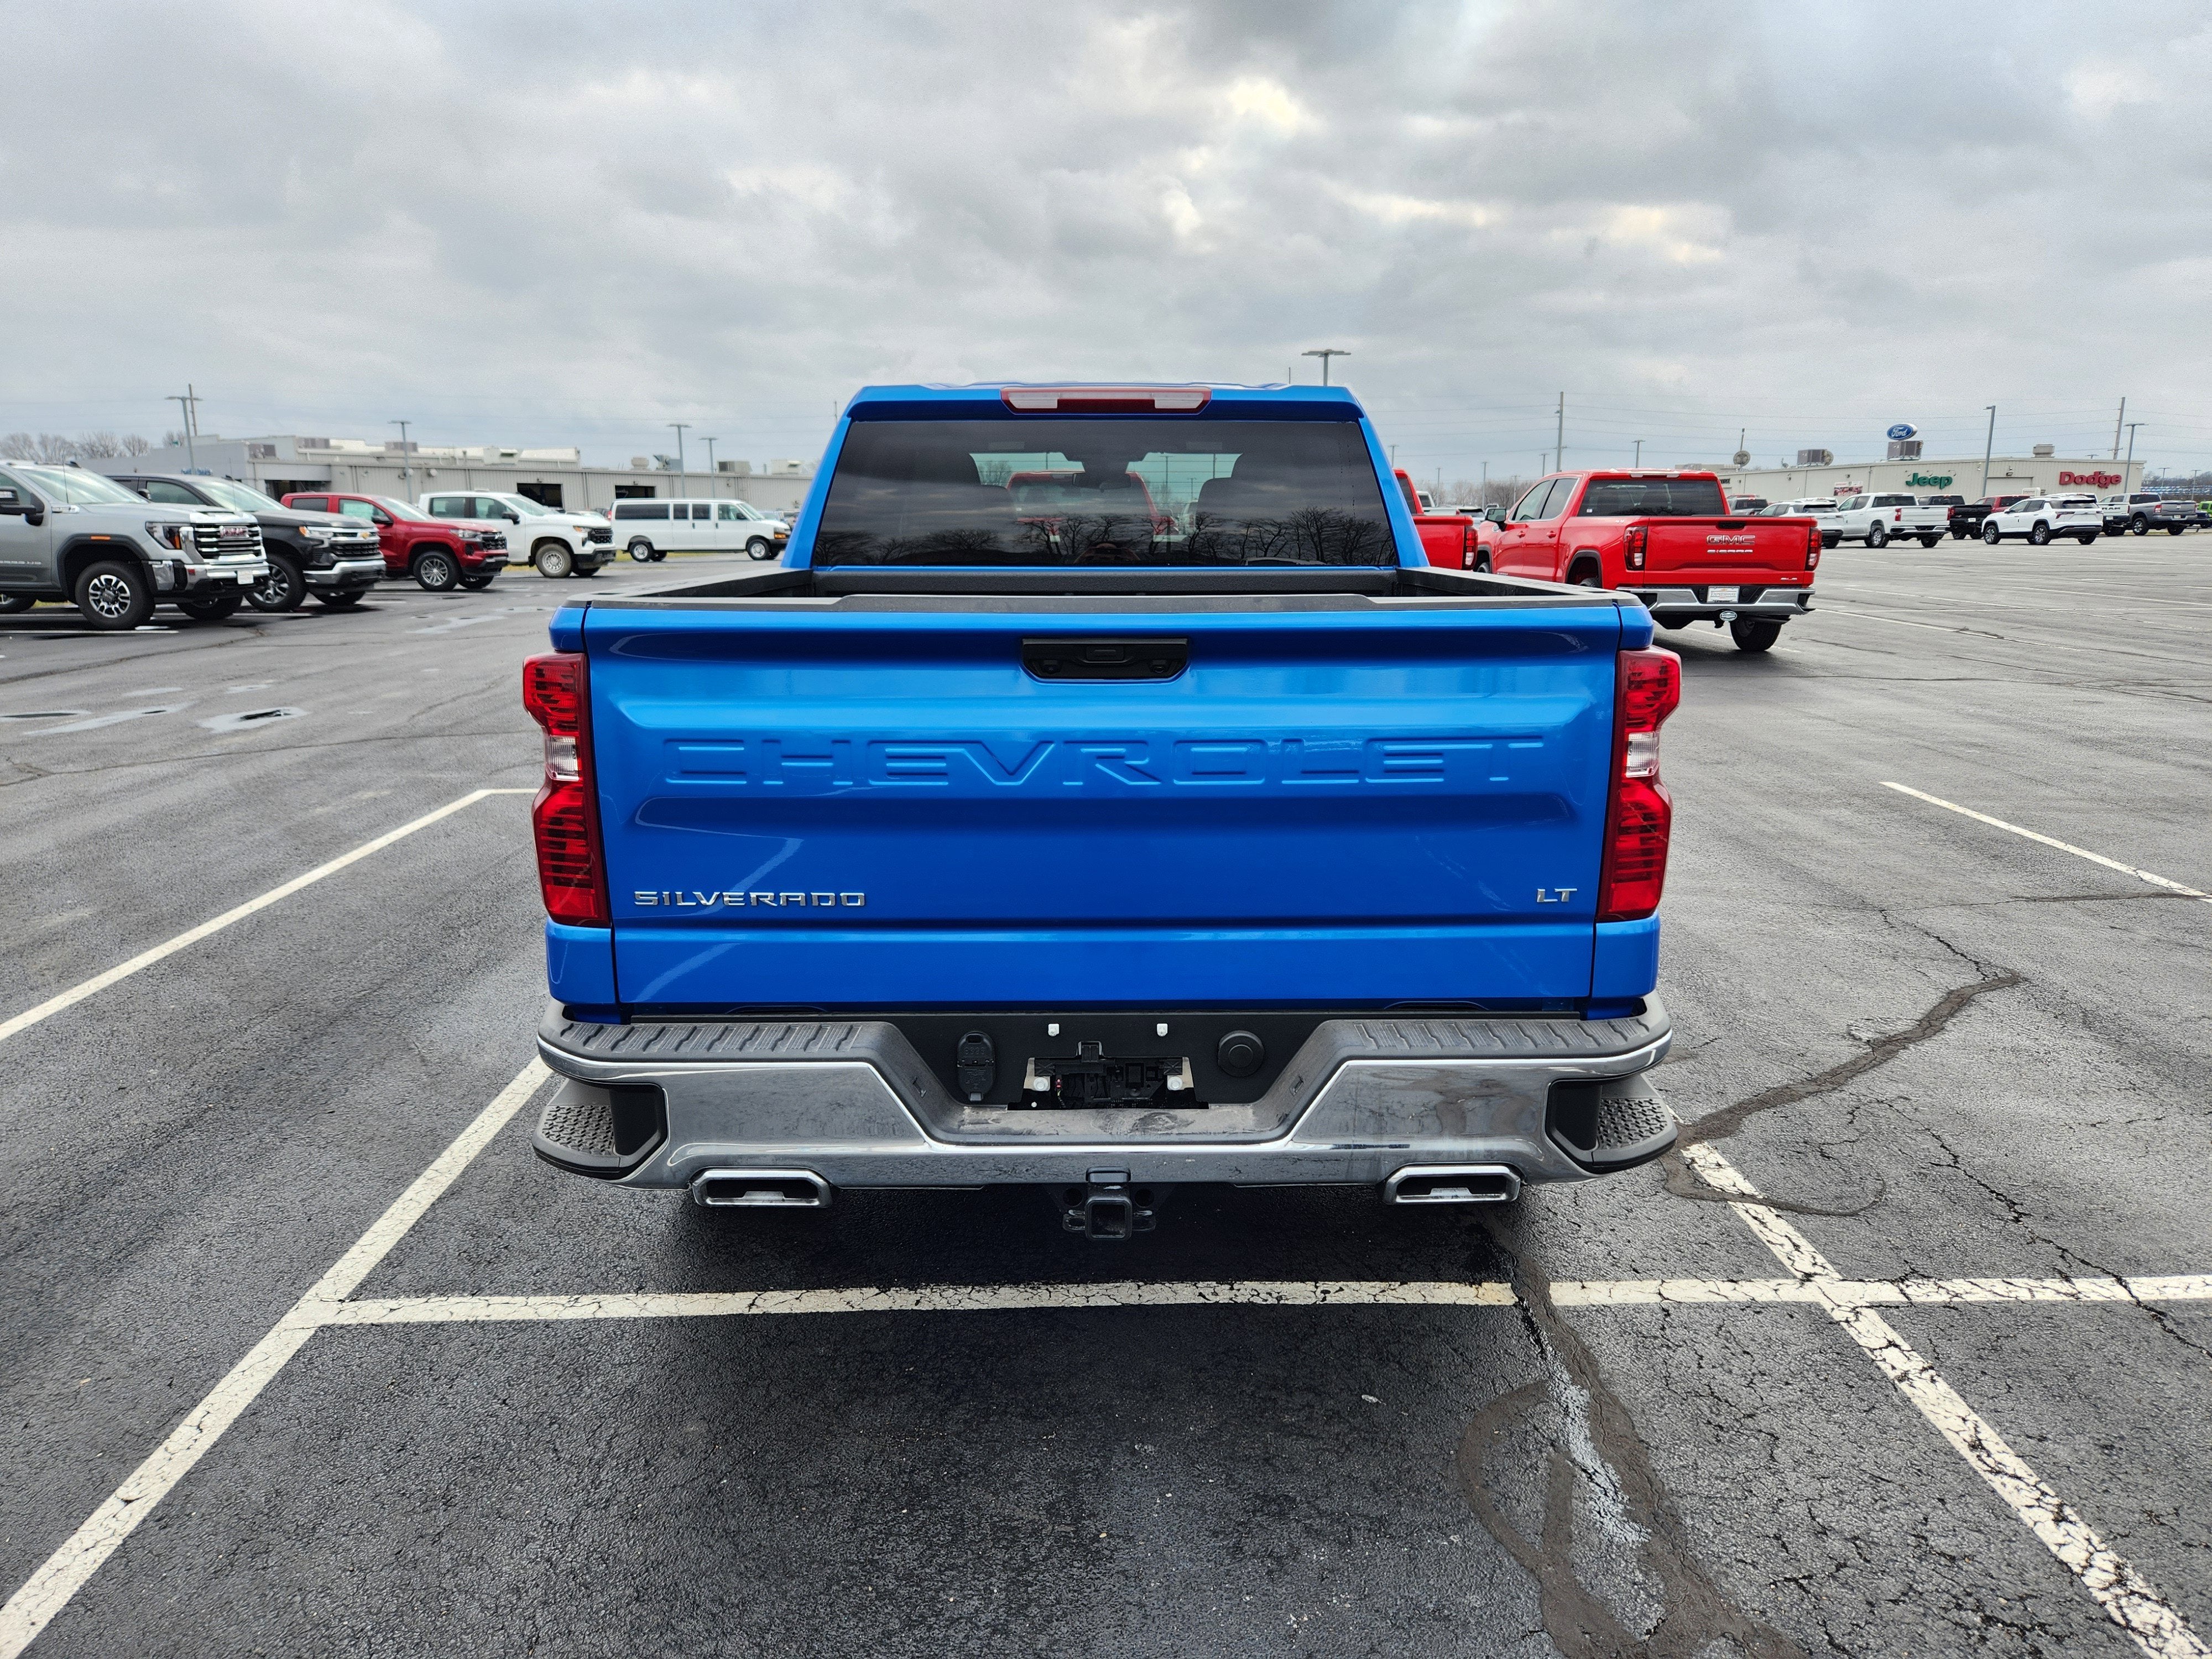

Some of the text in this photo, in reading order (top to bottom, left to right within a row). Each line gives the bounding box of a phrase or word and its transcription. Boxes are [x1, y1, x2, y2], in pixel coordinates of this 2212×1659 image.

[1891, 427, 1908, 437] Ford
[1905, 472, 1953, 490] Jeep
[2059, 471, 2122, 489] Dodge
[1706, 535, 1756, 545] GMC
[662, 737, 1546, 786] CHEVROLET
[634, 891, 866, 906] SILVERADO
[1537, 888, 1577, 902] LT
